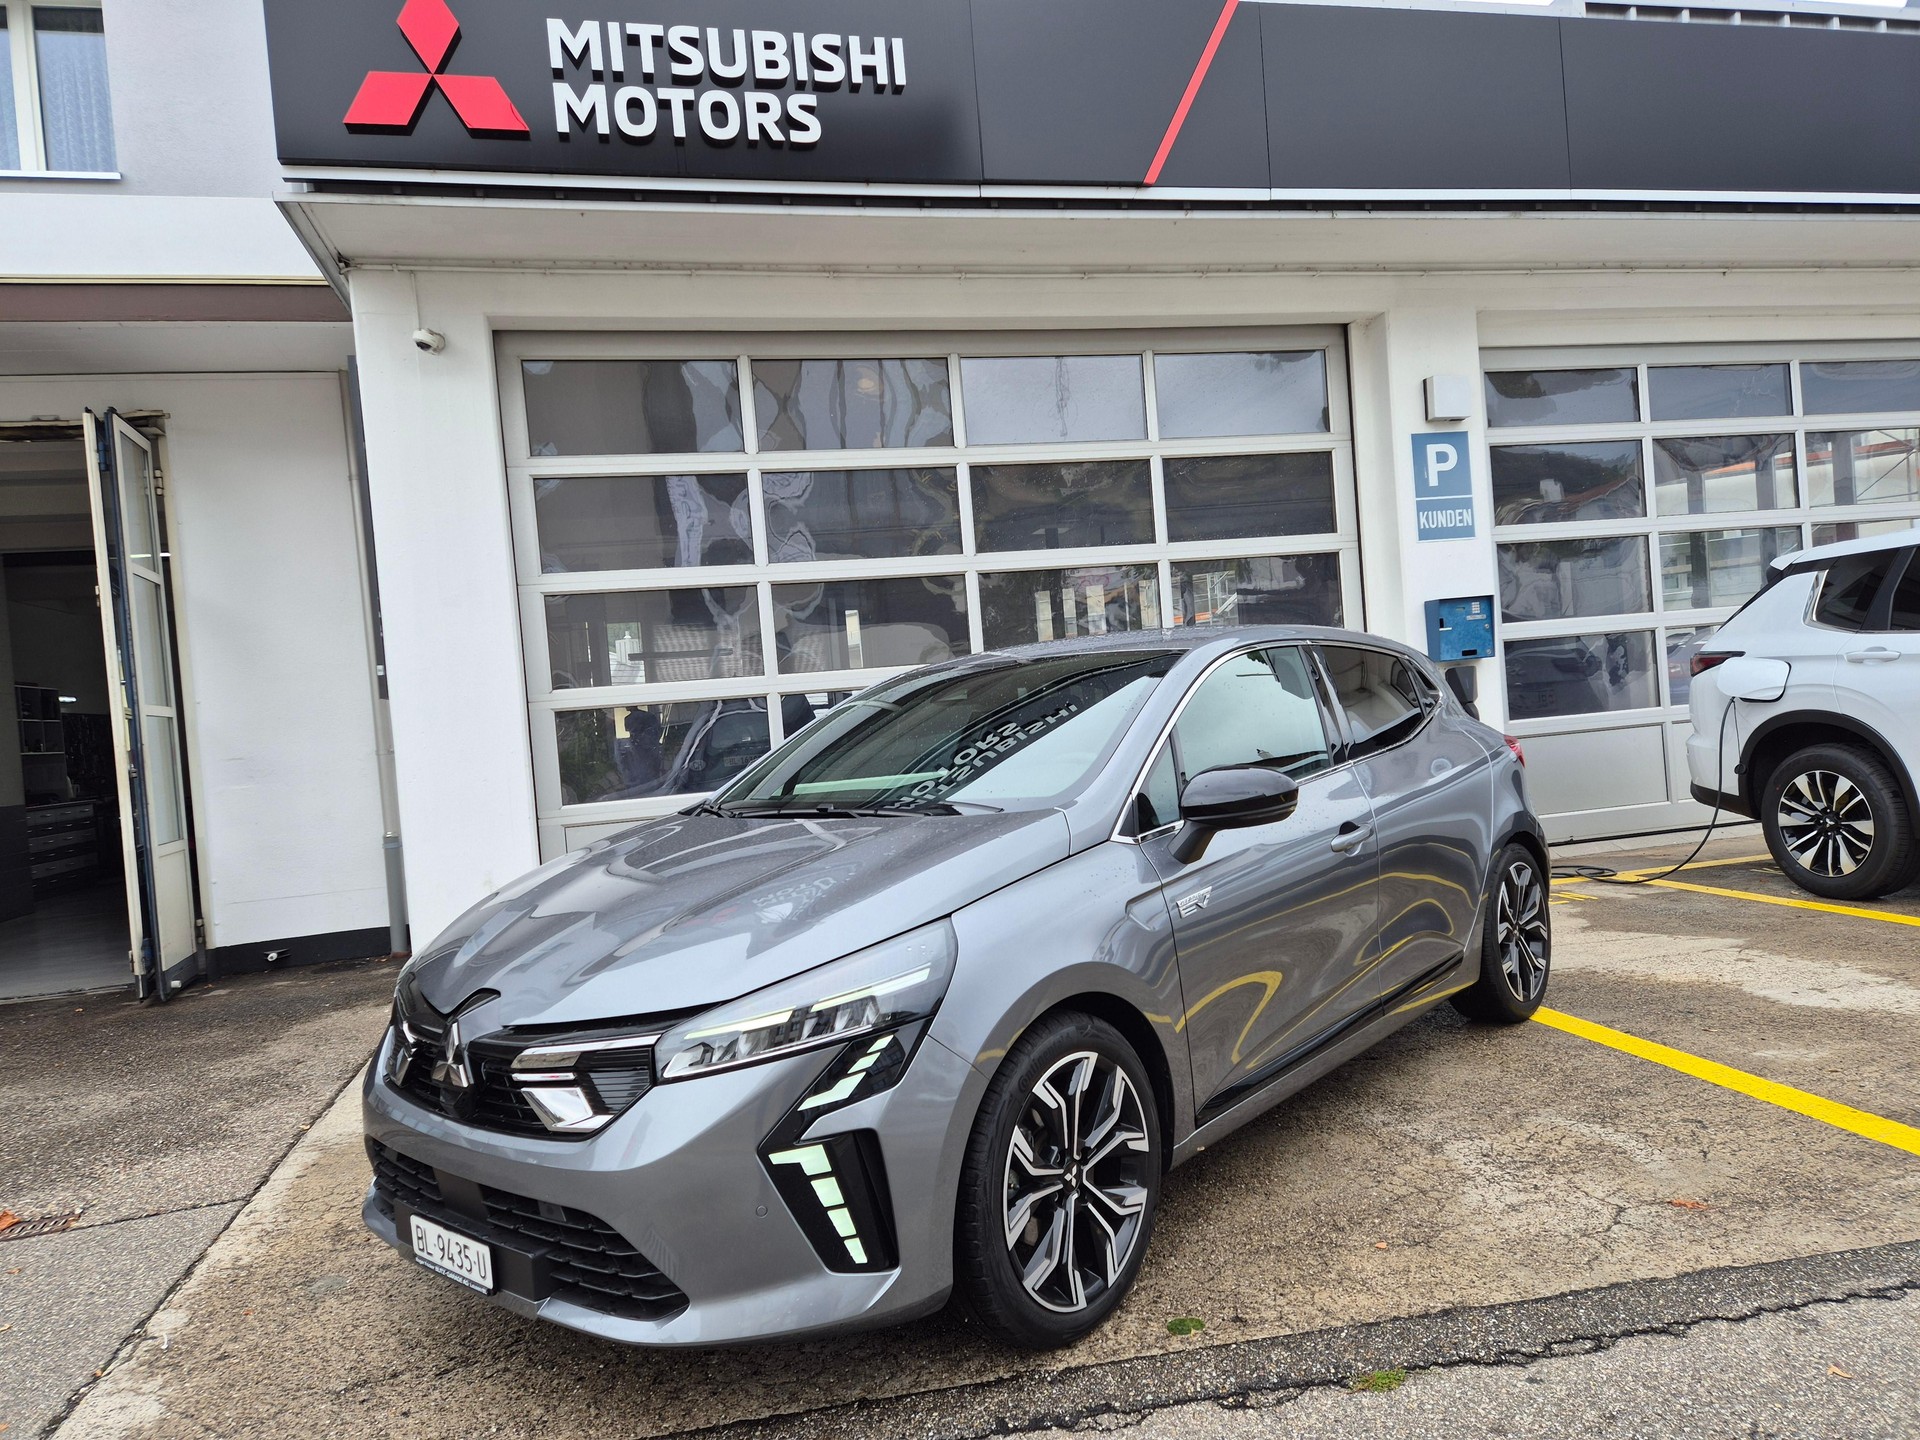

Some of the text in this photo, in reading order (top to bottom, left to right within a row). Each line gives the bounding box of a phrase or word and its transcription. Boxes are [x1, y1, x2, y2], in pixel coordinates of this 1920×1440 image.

[546, 18, 906, 86] MITSUBISHI
[552, 82, 822, 144] MOTORS
[1426, 443, 1458, 487] P
[1419, 508, 1473, 530] KUNDEN
[1178, 892, 1210, 918] EV
